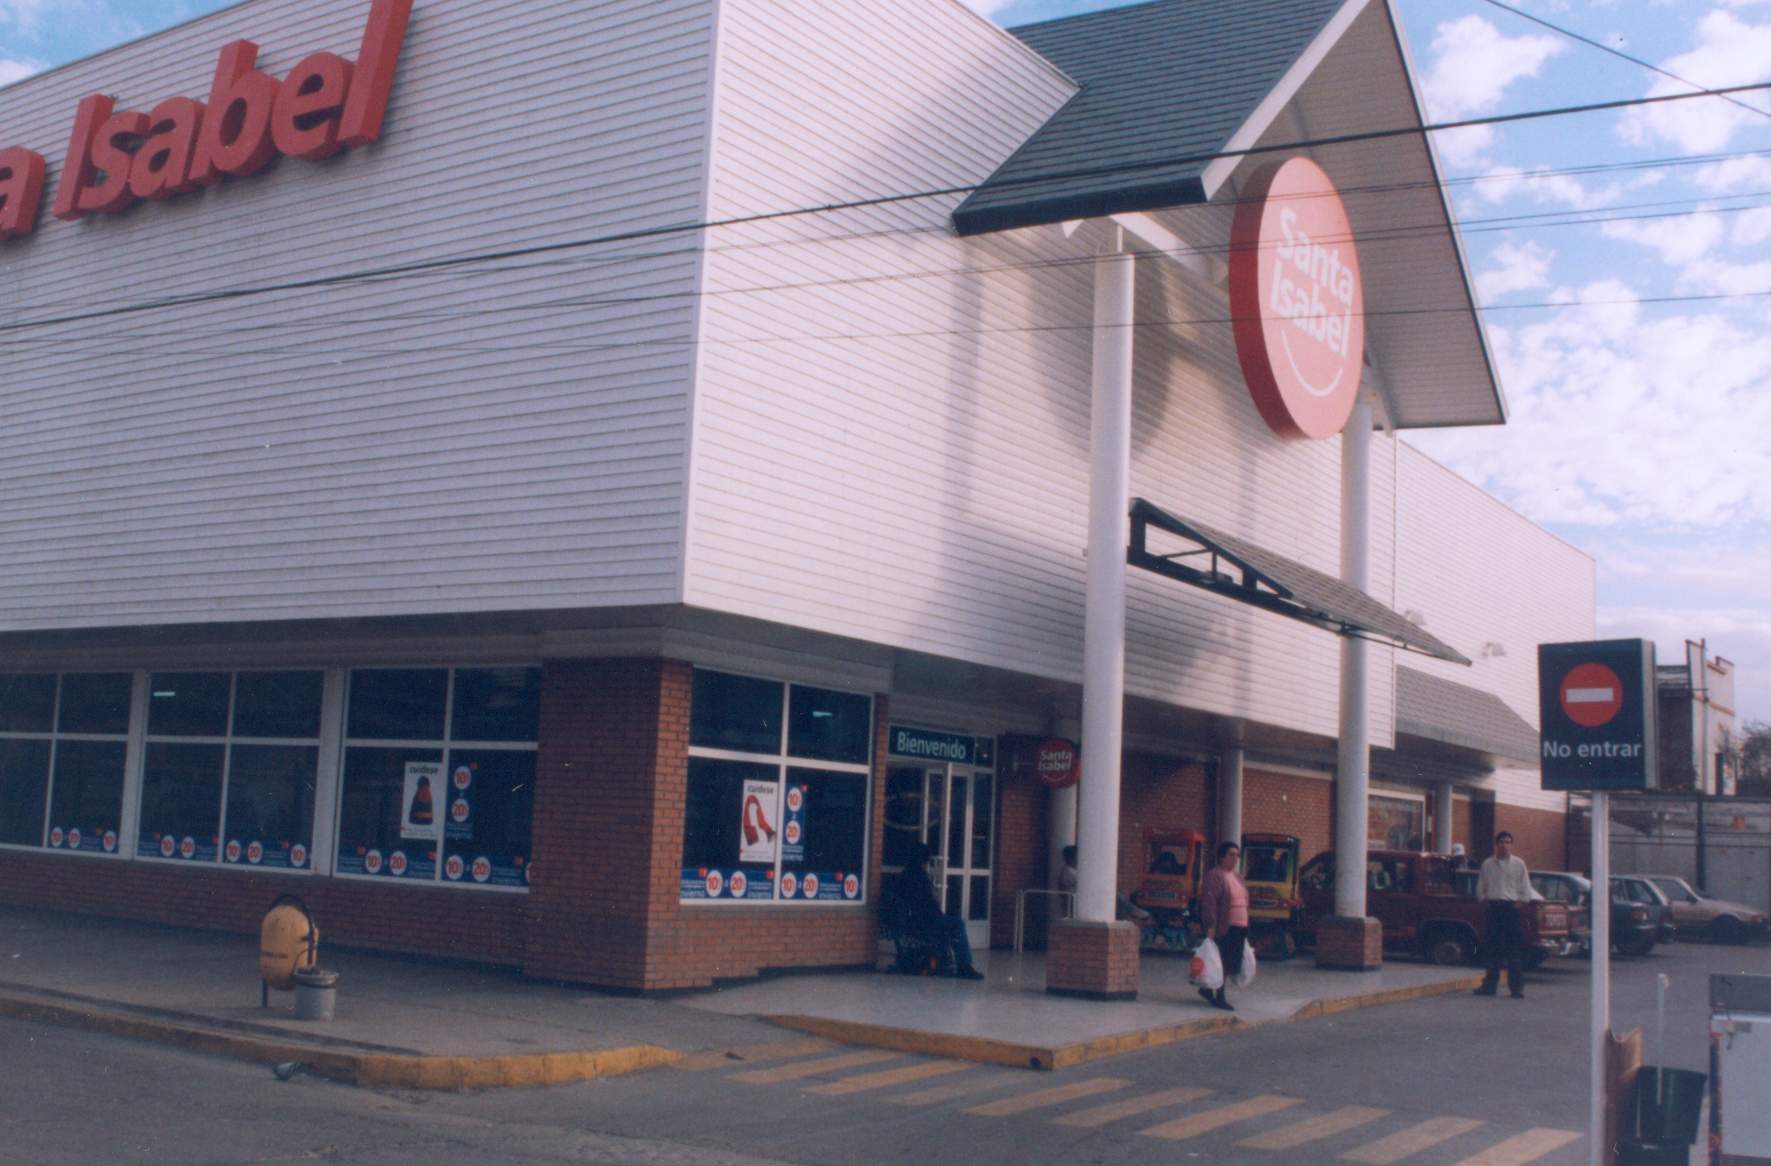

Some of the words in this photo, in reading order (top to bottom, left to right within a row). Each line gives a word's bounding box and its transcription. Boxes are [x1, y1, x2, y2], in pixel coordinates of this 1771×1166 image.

[53, 0, 414, 221] Isabel
[1280, 208, 1353, 304] Santa
[1270, 258, 1352, 356] Isabel
[897, 731, 966, 760] Bienvenido
[1543, 740, 1571, 758] No
[1577, 741, 1641, 758] entrar
[1040, 749, 1073, 761] Santa
[1038, 760, 1072, 771] Isabel
[708, 876, 719, 891] 10
[732, 877, 743, 891] 20
[783, 878, 793, 892] 10
[805, 878, 816, 892] 20
[846, 880, 856, 893] 10
